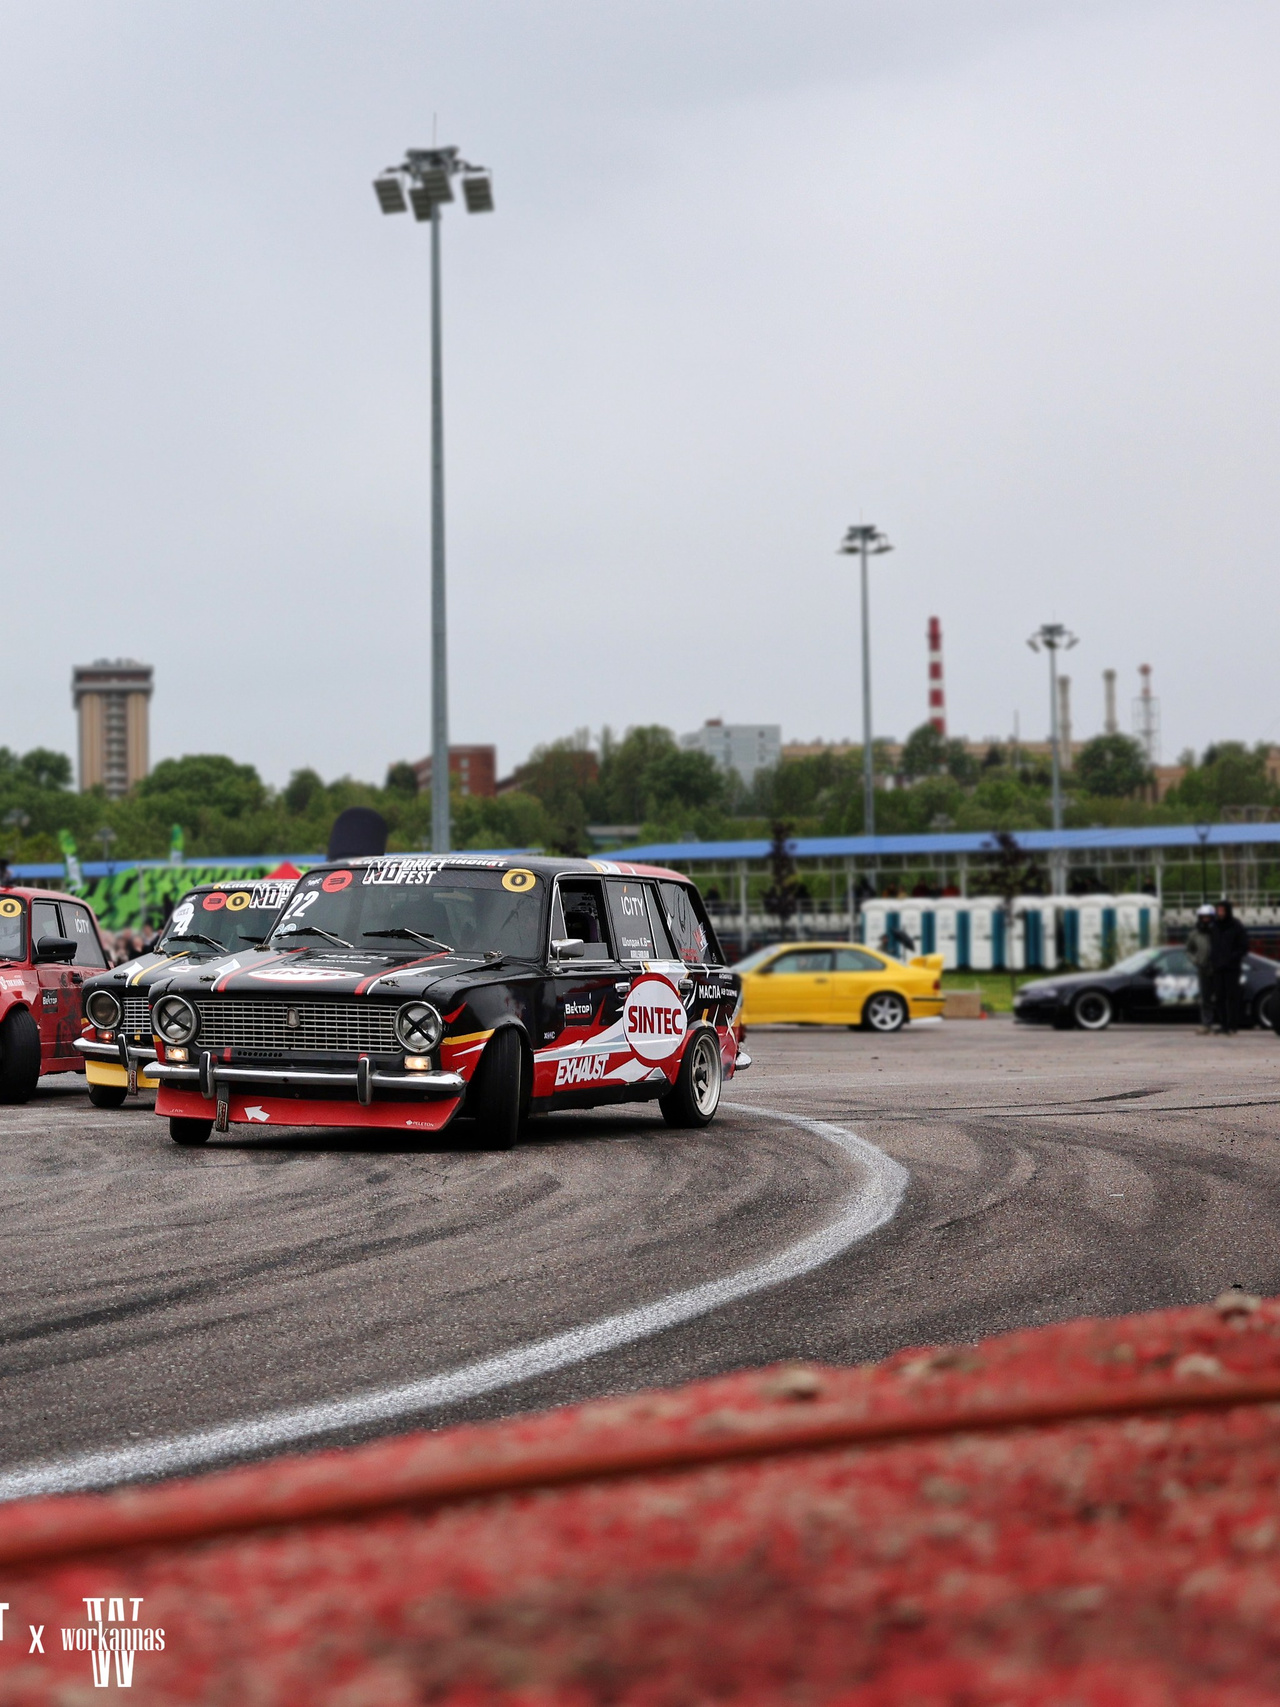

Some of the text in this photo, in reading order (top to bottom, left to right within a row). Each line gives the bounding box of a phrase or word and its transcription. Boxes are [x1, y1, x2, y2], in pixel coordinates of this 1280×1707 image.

[401, 859, 446, 871] DRIFT
[397, 871, 437, 884] FEST
[281, 890, 319, 920] 22
[699, 985, 721, 999] МАСЛА
[628, 1005, 683, 1035] SINTEC
[555, 1054, 611, 1086] EXHAUST
